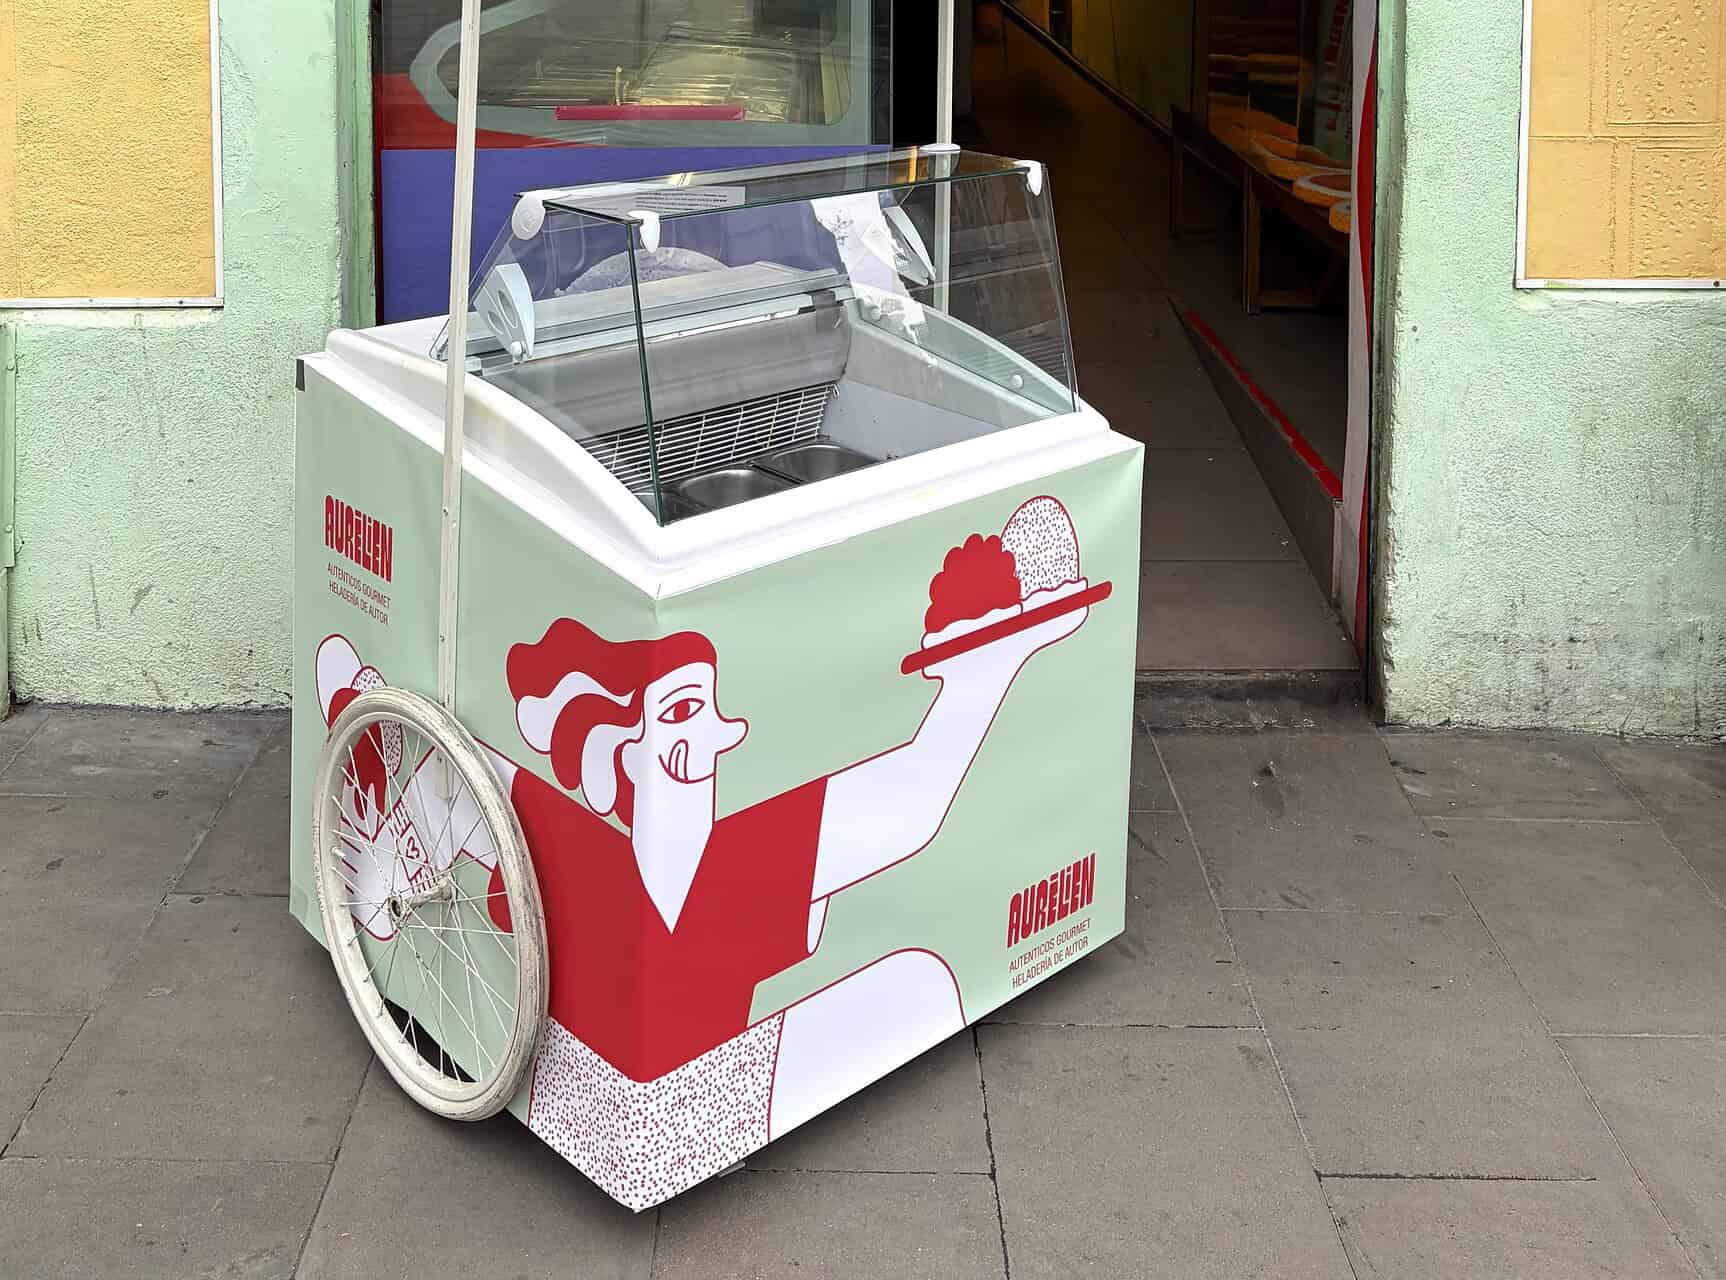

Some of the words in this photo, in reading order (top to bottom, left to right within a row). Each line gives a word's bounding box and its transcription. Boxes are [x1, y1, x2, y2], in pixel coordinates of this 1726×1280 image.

[362, 583, 391, 609] GOURMET
[360, 598, 369, 613] DE
[369, 604, 389, 625] AUTOR
[1056, 918, 1091, 946] GOURMET
[1053, 951, 1064, 966] DE
[1064, 935, 1089, 960] AUTOR
